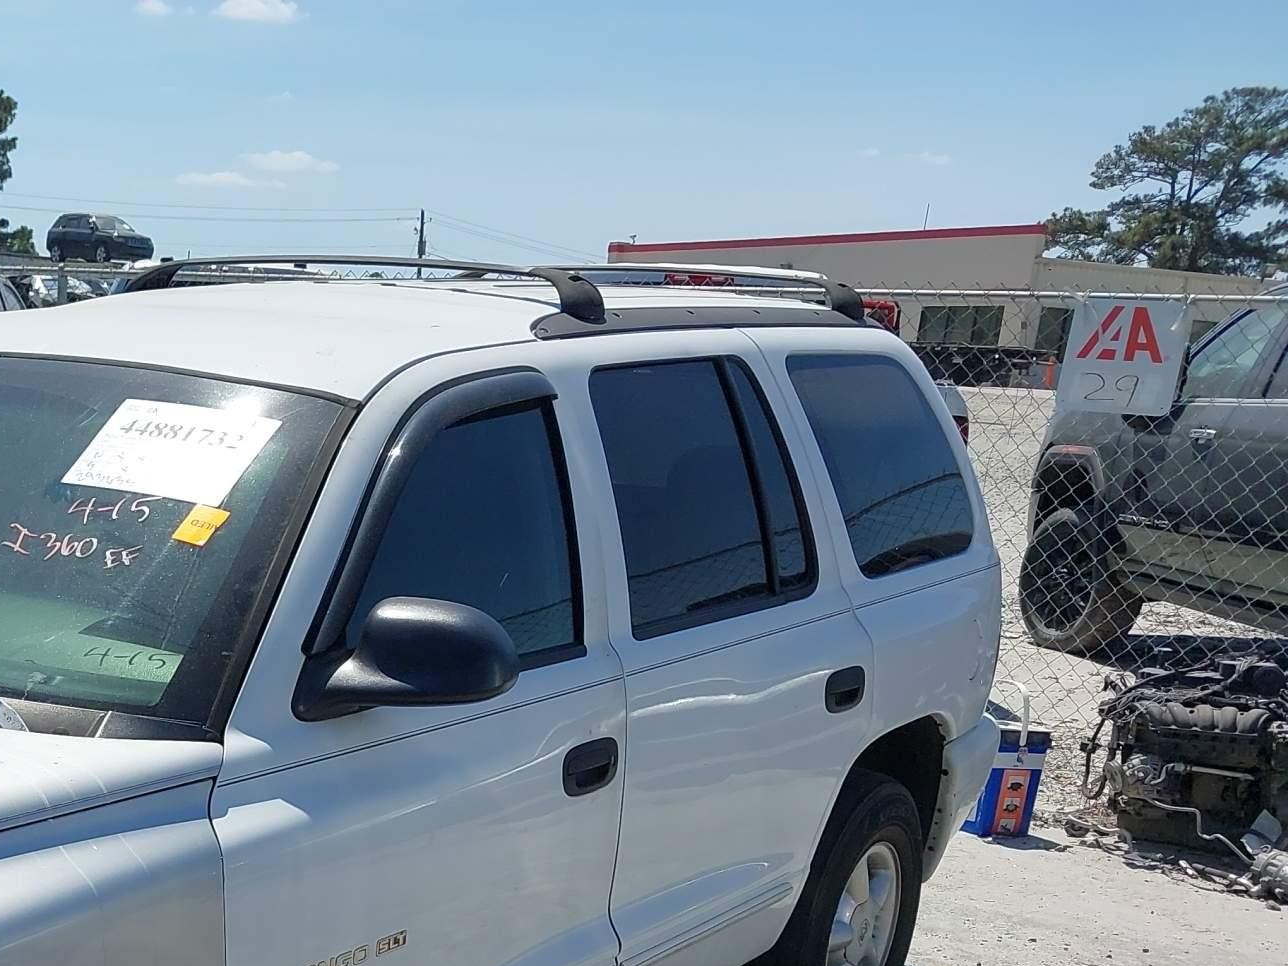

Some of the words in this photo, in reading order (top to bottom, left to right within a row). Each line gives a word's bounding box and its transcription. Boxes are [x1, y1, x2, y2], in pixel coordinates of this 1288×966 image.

[1081, 372, 1139, 407] 29
[119, 419, 244, 449] 44881732
[67, 496, 164, 524] 4-15
[376, 930, 408, 957] SLT
